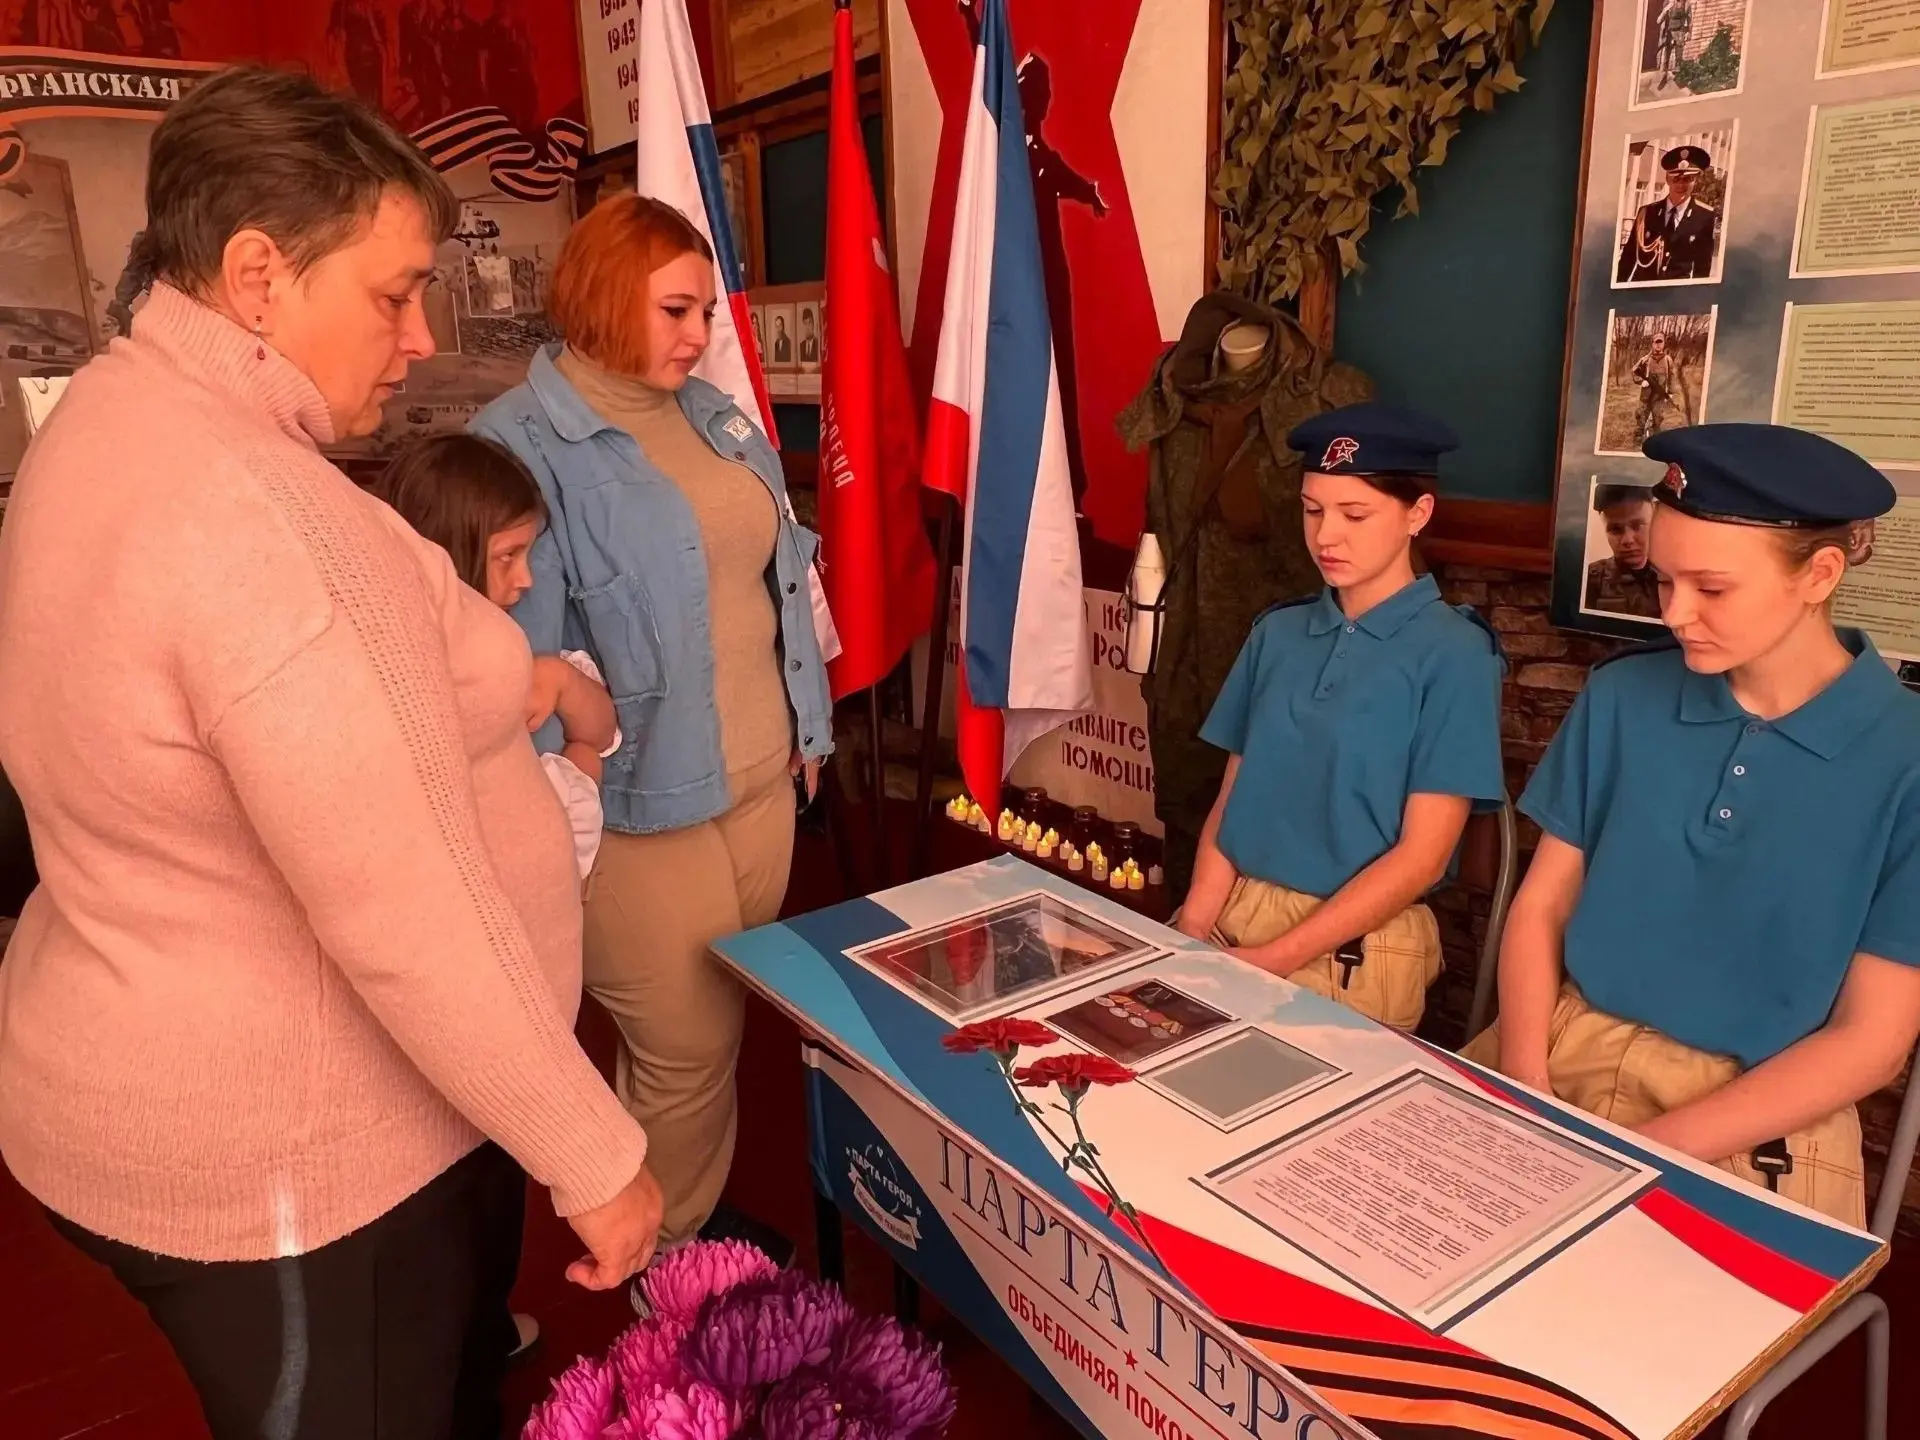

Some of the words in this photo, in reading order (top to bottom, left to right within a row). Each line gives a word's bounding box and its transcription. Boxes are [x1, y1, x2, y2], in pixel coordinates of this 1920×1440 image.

[607, 18, 636, 54] 1943
[617, 58, 639, 89] 194
[851, 1147, 881, 1183] ПАРТА
[882, 1175, 913, 1209] ГЕРОЯ
[936, 1130, 1129, 1335] ПАРТА
[1008, 1284, 1119, 1401] ОБЪЕДИНЯЯ
[1126, 1383, 1195, 1440] ПОКО
